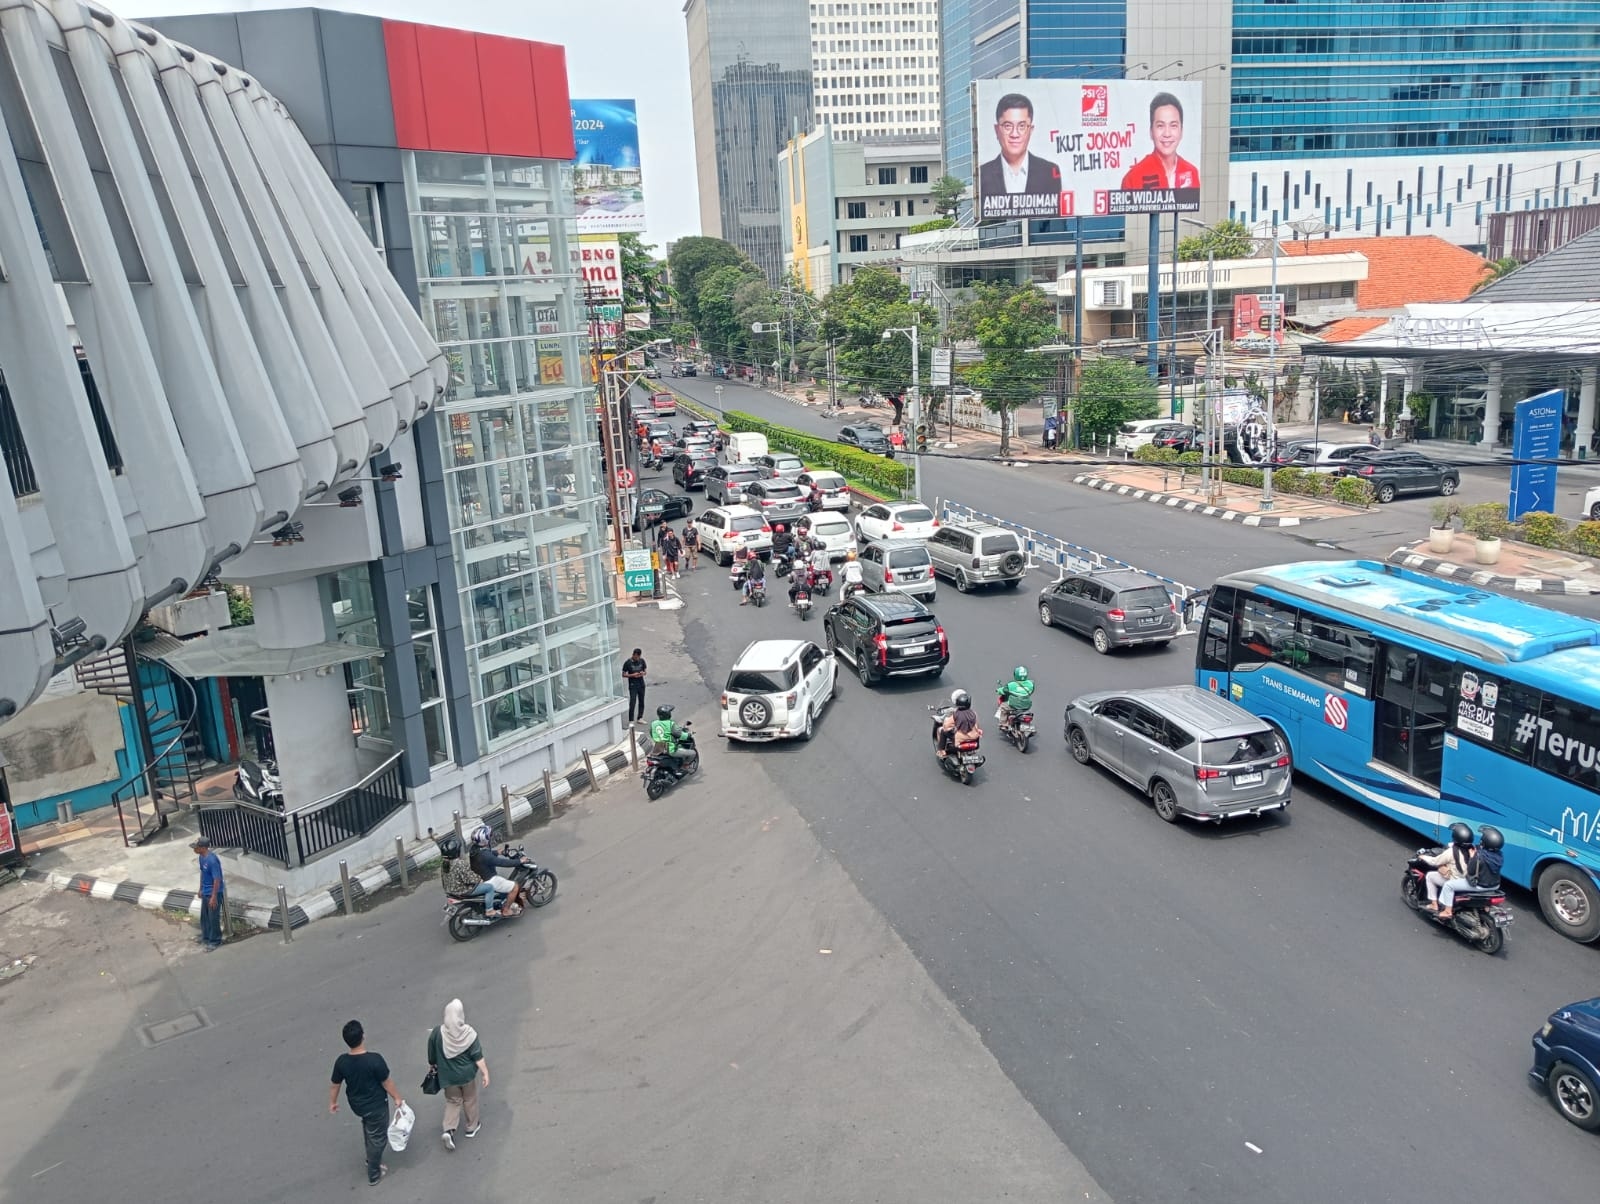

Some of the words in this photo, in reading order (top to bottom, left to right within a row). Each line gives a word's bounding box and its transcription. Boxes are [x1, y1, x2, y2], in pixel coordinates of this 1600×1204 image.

[1082, 89, 1096, 98] PSI
[574, 120, 604, 130] 2024
[1056, 134, 1084, 154] IKUT
[1086, 130, 1132, 150] JOKOWI
[1073, 152, 1101, 172] PILIH
[1104, 151, 1120, 168] PSI
[984, 196, 1011, 209] ANDY
[1012, 194, 1058, 208] BUDIMAN
[1064, 194, 1071, 214] 1
[1096, 193, 1106, 212] 5
[1110, 192, 1130, 205] ERIC
[1133, 190, 1176, 204] WIDJAJA
[536, 248, 615, 263] BDENG
[538, 308, 558, 322] OTA
[1529, 408, 1550, 416] ASTON
[1262, 675, 1283, 692] TRANS
[1284, 684, 1320, 708] SEMARANG
[1459, 700, 1476, 712] AYO
[1458, 708, 1476, 720] NAIK
[1476, 708, 1496, 726] BUS
